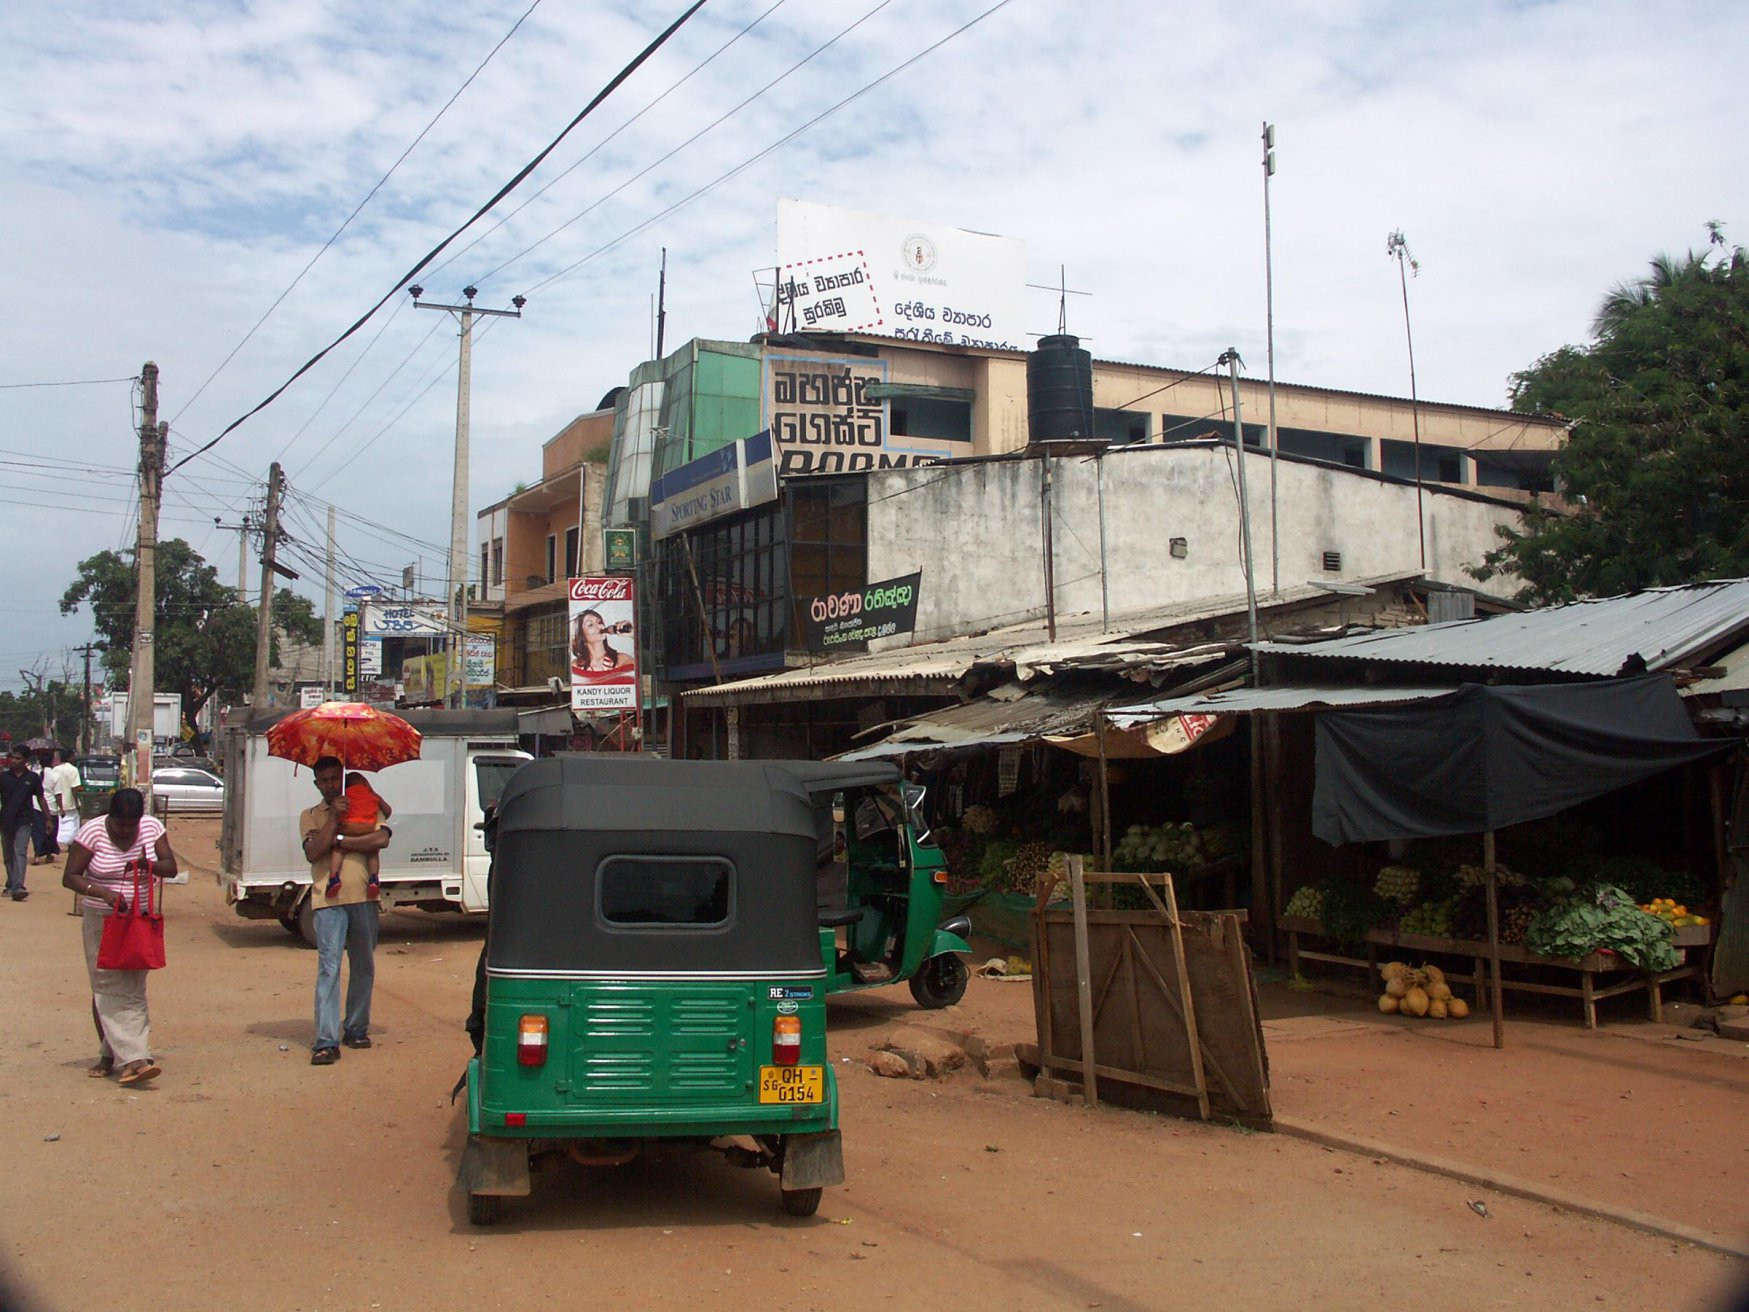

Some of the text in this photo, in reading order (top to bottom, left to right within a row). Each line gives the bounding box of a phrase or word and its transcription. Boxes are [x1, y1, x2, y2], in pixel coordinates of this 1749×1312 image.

[671, 486, 732, 523] SPORTING STAR
[571, 579, 629, 600] Coca-Cola
[384, 608, 415, 619] HOTEL
[811, 591, 862, 622] රාවණා
[577, 686, 631, 696] KANDY LIQUOR
[580, 697, 628, 706] RESTAURANT
[770, 988, 783, 998] RE
[784, 989, 790, 998] 2
[782, 1068, 803, 1084] QH
[778, 1086, 814, 1102] 0154
